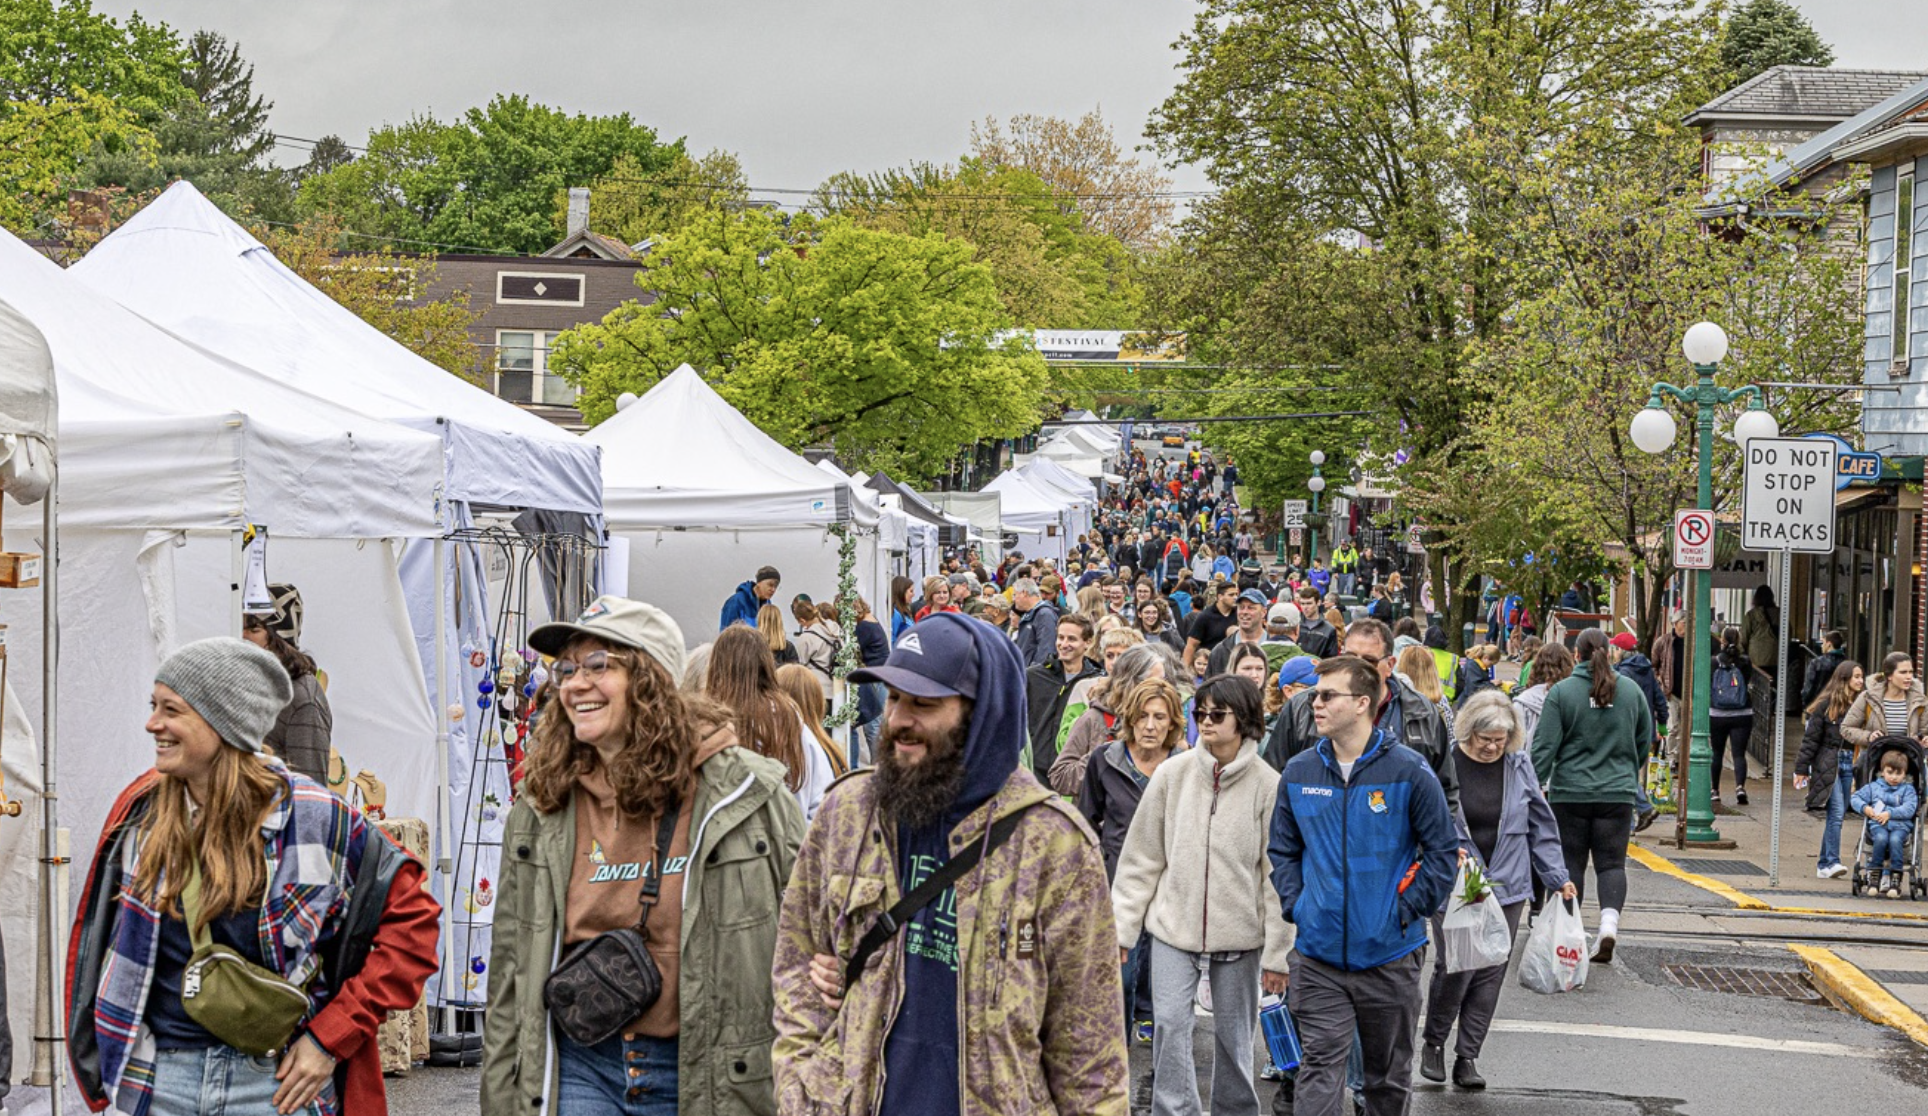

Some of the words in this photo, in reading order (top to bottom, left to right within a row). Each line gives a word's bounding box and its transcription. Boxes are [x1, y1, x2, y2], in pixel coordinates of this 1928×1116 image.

[1050, 337, 1107, 346] FESTIVAL
[1751, 448, 1777, 466] DO
[1789, 448, 1831, 467] NOT
[1838, 455, 1877, 475] CAFE
[1764, 473, 1817, 491] STOP
[1776, 498, 1803, 515] ON
[1287, 514, 1303, 525] 25
[1748, 521, 1829, 541] TRACKS
[1302, 787, 1332, 797] macron
[589, 862, 640, 883] SANTA
[641, 856, 688, 877] CUZ
